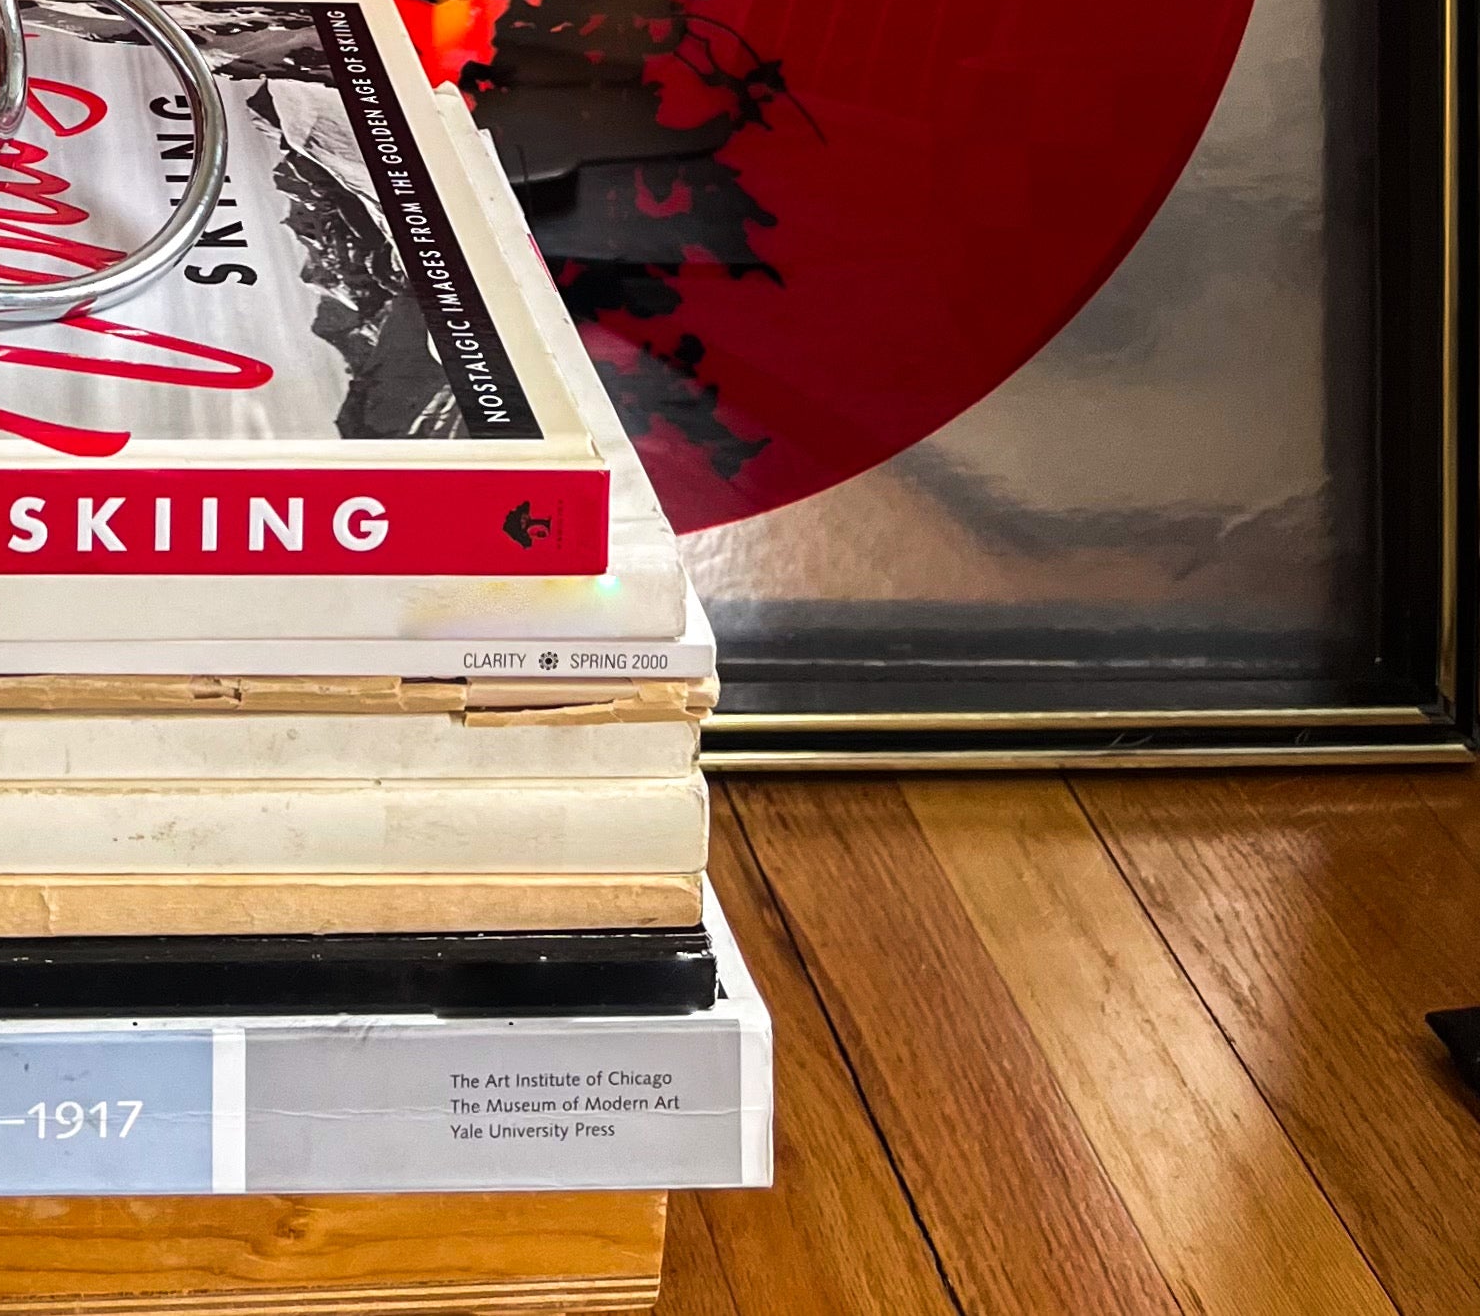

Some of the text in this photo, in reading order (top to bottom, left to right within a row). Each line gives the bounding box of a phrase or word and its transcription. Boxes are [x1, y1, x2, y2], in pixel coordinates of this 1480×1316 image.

[326, 10, 511, 423] NOSTALGIC IMAGES FROM THE GOLDEN AGE OF SKIING
[7, 496, 389, 553] SKIING
[463, 652, 668, 670] CLARITY SPRING 2000
[450, 1070, 673, 1089] The Art Institute of Chicago
[450, 1095, 680, 1114] The Museum of Modern Art
[450, 1122, 615, 1142] Yale University Press
